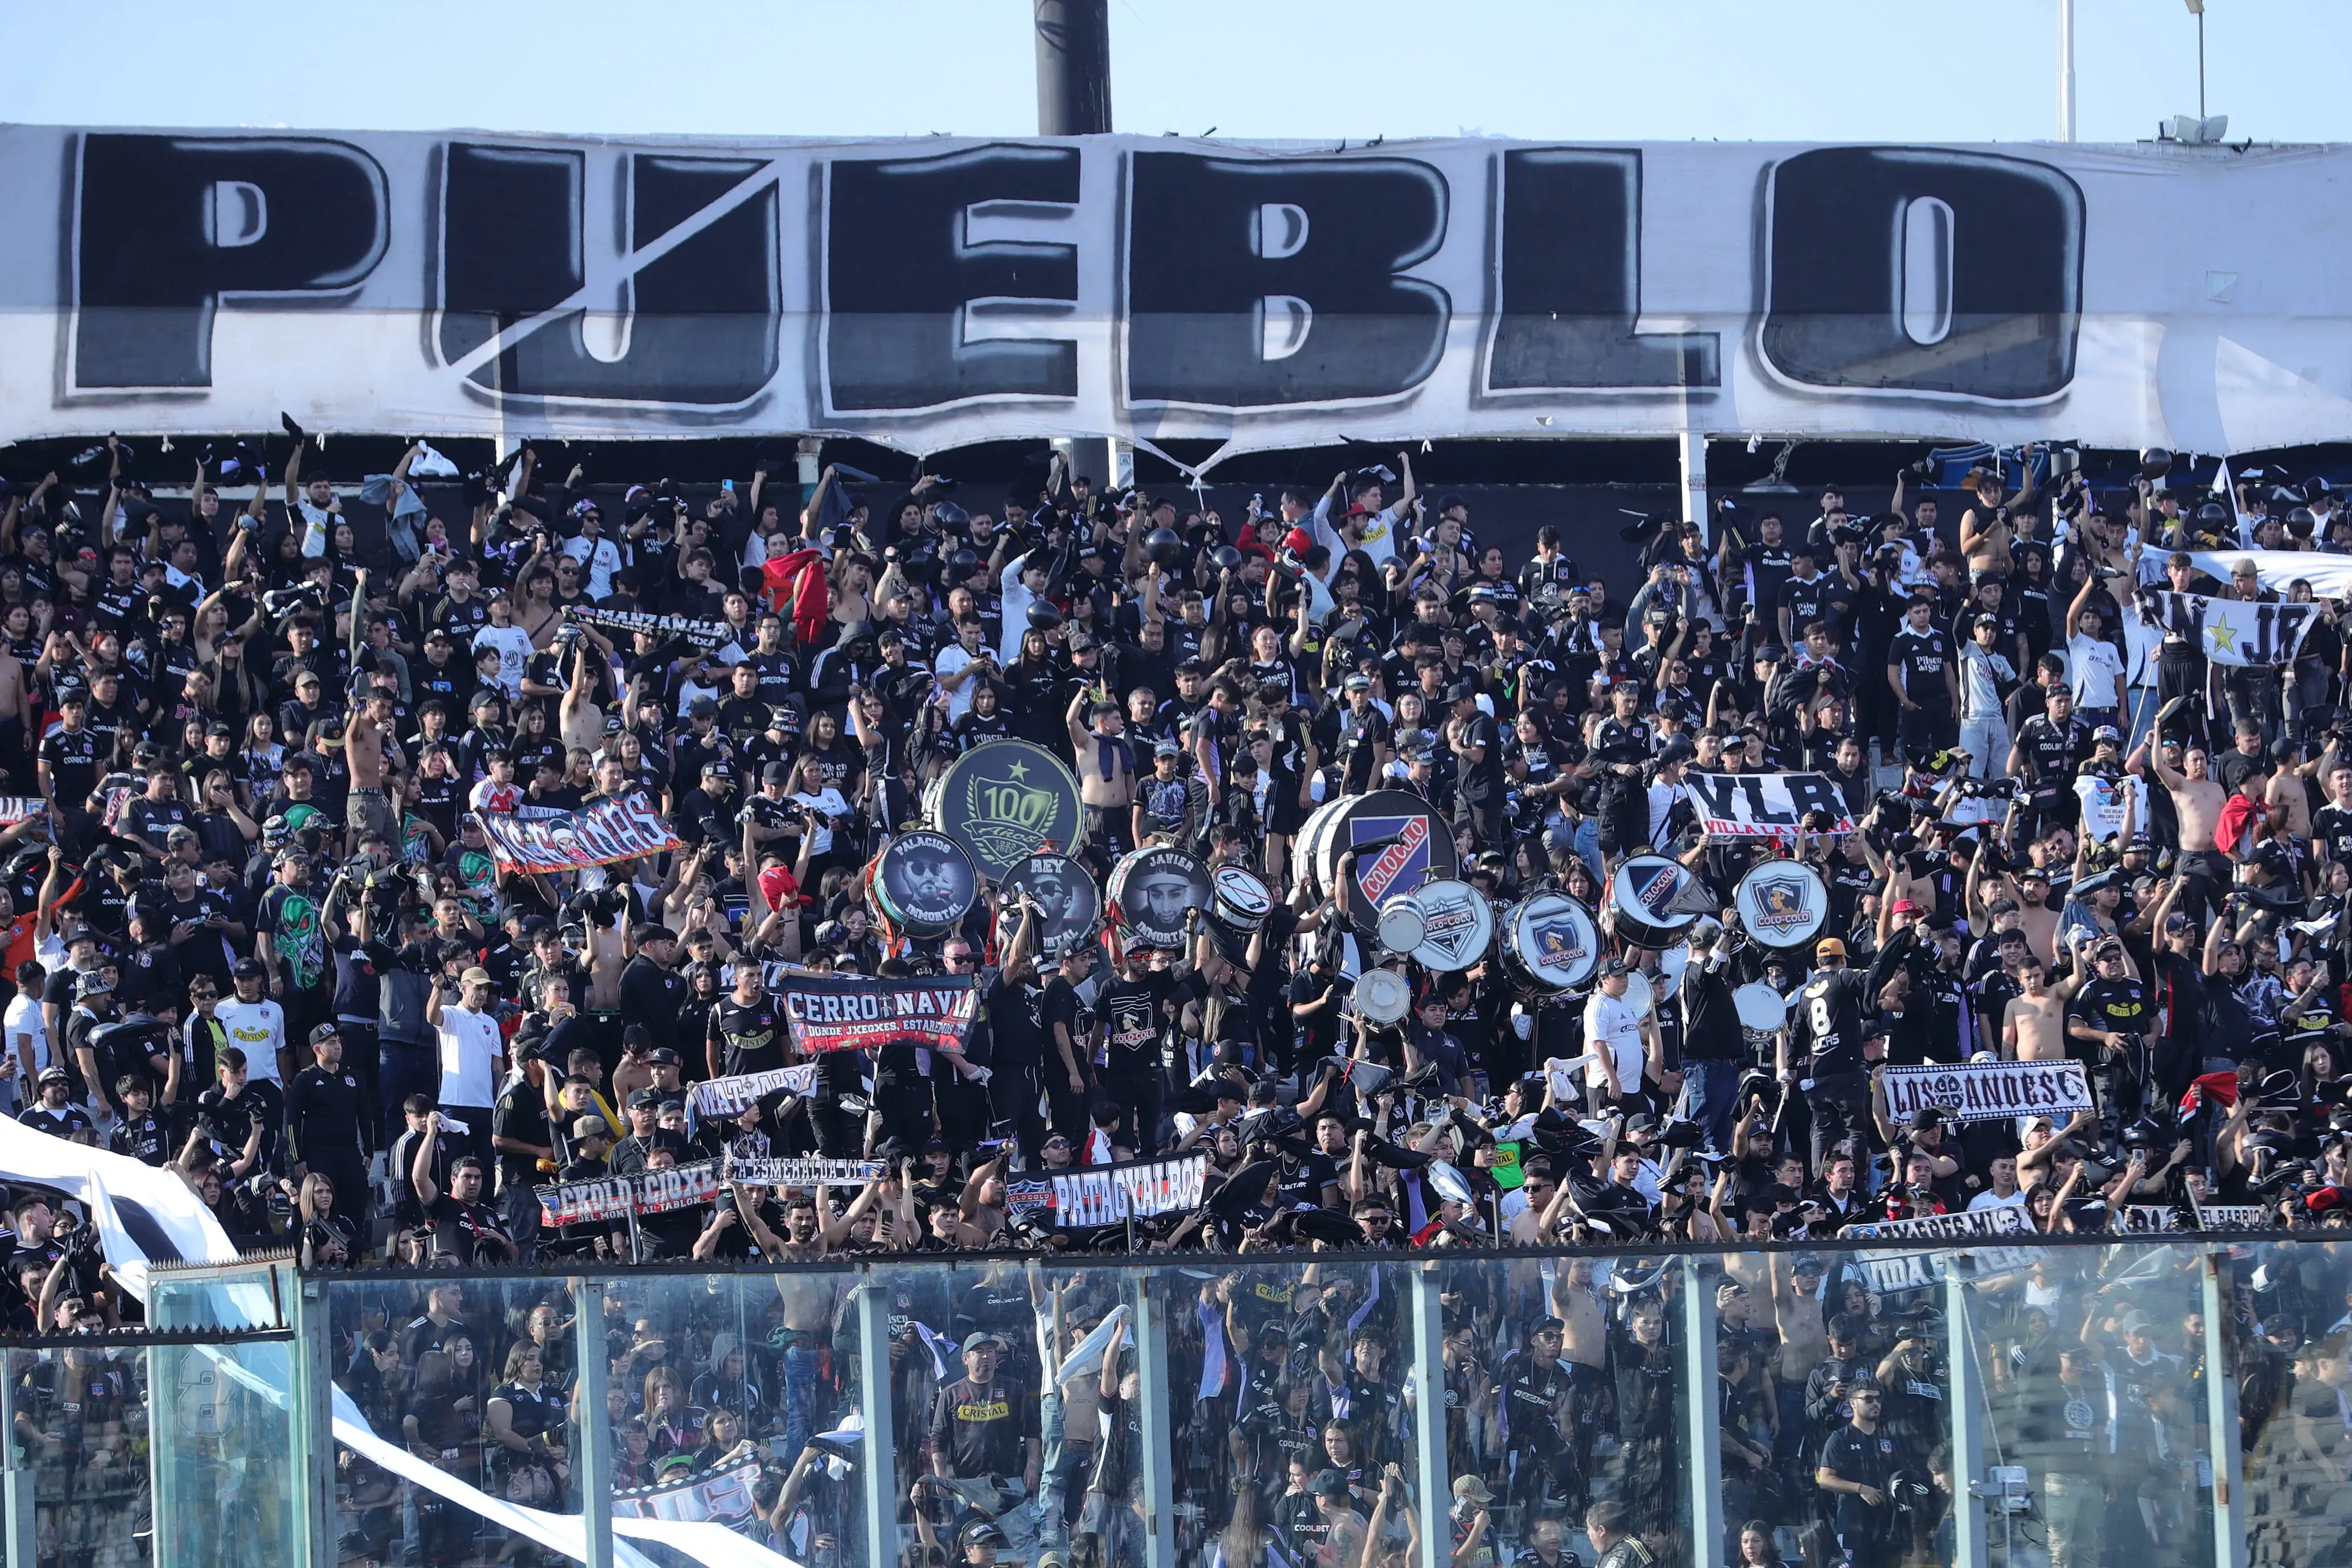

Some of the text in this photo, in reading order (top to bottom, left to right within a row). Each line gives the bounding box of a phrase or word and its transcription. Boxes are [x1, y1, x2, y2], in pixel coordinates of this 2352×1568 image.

[56, 132, 2088, 414] PUEBLO
[1916, 656, 1942, 666] Pilsen
[1683, 773, 1848, 824] VLR
[985, 787, 1044, 829] 100
[978, 826, 1039, 842] Años
[1704, 820, 1758, 835] VILLA
[1763, 825, 1790, 834] LA
[895, 836, 951, 857] PALACIOS
[1030, 858, 1066, 873] REY
[1149, 853, 1194, 873] JAVIER
[1366, 854, 1399, 894] COLO
[1640, 866, 1678, 907] COLO-COLO
[905, 903, 964, 921] INMORTAL
[1757, 913, 1810, 927] COLO-COLO
[1136, 920, 1188, 943] INMORTA
[1425, 913, 1472, 932] OLO-COLO
[1540, 949, 1585, 966] COLO-COLO
[787, 989, 976, 1023] CERRO NAVIA
[1810, 997, 1831, 1036] 8
[235, 1029, 267, 1041] CRISTAL
[808, 1025, 842, 1037] DONDE
[903, 1019, 954, 1035] ESTAREMOS
[739, 1034, 771, 1049] RISTAL
[1891, 1069, 2059, 1116] LOS ANDES
[753, 1159, 837, 1179] ESMERALDA
[1495, 1154, 1512, 1166] STAL
[577, 1213, 598, 1223] DEL
[642, 1204, 657, 1216] AL
[659, 1195, 702, 1213] TABLON
[2219, 1208, 2261, 1226] BARRIO
[1445, 1390, 1458, 1405] MG
[963, 1404, 1006, 1419] CRISTAL
[1278, 1439, 1309, 1450] COOLBET
